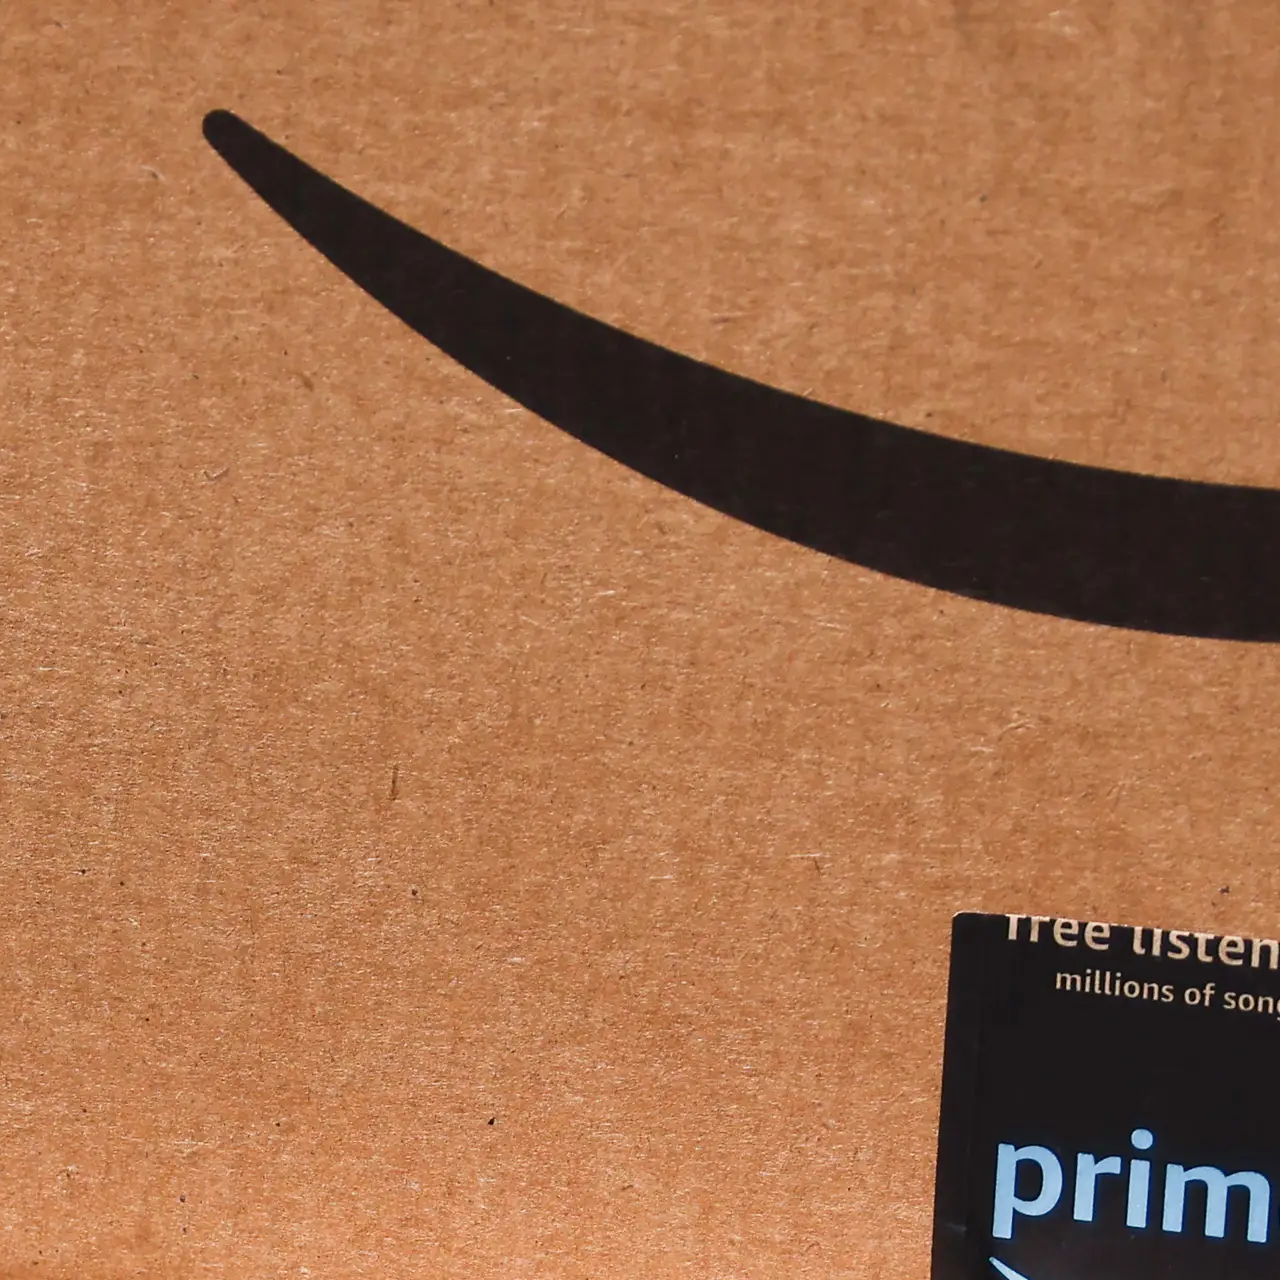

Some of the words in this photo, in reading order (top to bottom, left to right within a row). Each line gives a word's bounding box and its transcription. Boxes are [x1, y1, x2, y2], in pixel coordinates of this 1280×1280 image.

[1005, 914, 1111, 950] free
[1055, 968, 1175, 1002] millions
[1184, 982, 1216, 1007] of
